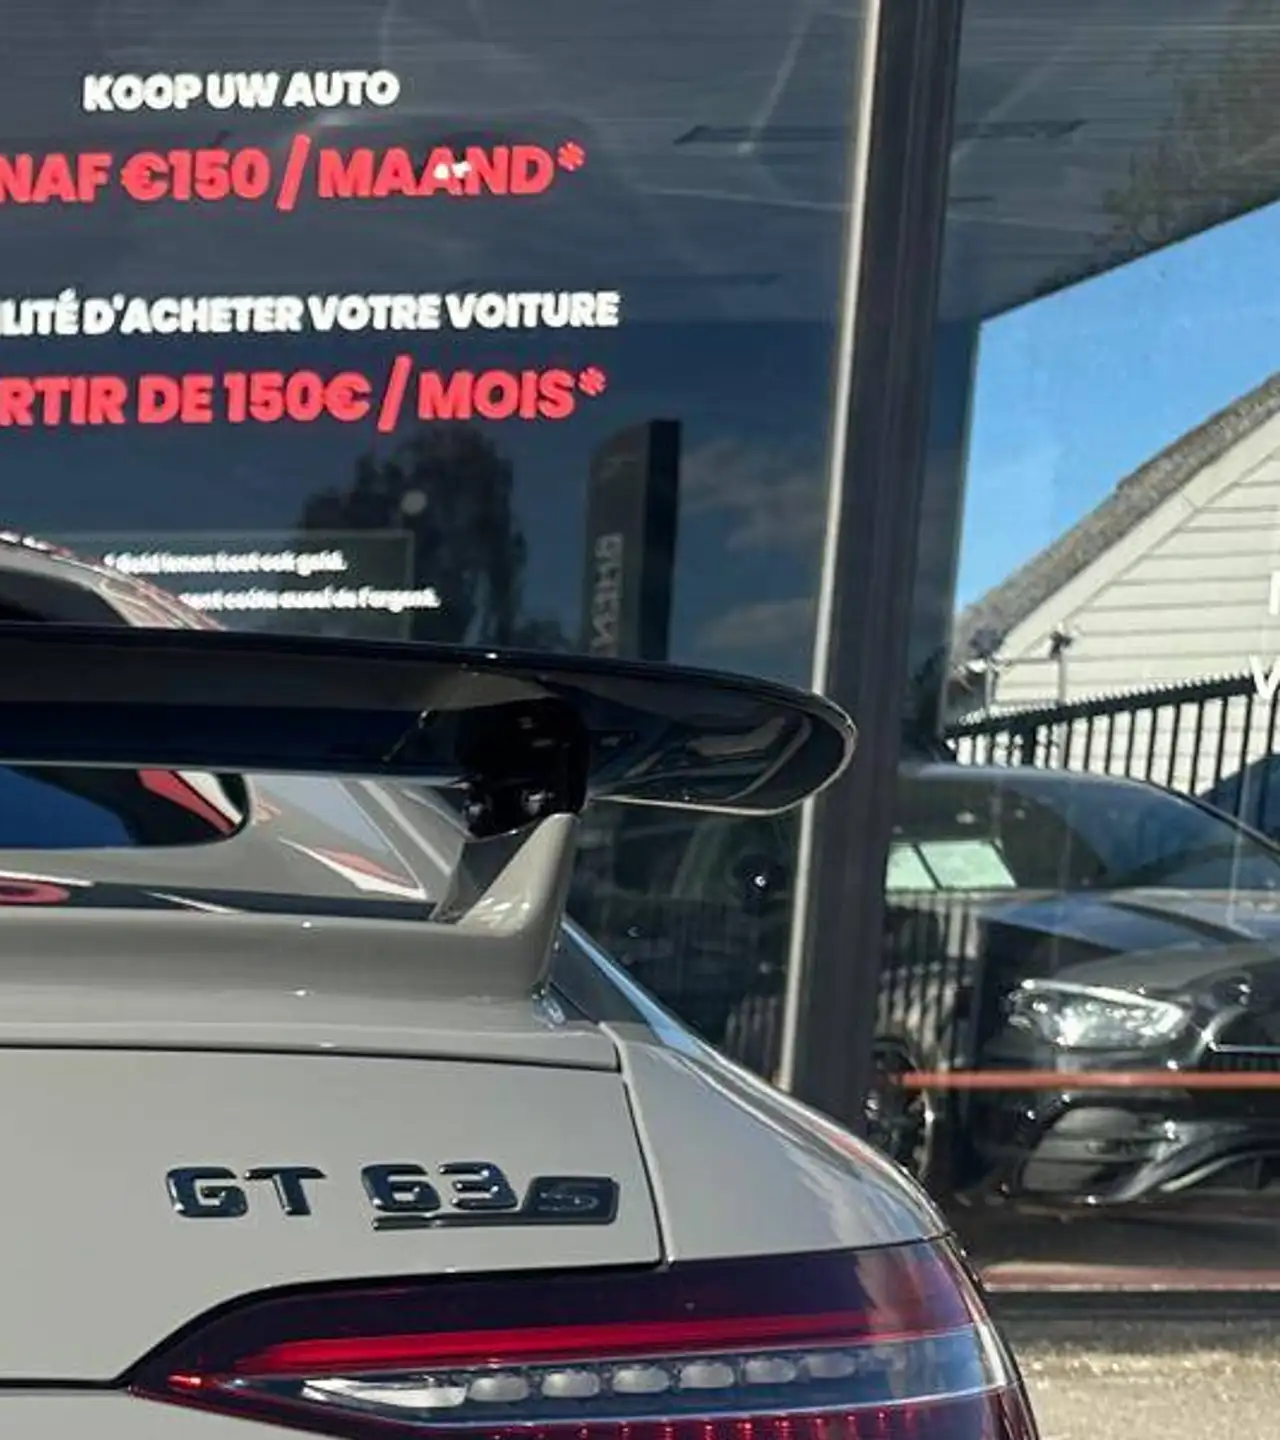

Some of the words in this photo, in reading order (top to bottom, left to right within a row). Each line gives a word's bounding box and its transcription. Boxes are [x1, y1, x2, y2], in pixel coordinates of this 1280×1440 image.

[82, 73, 203, 112] KOOP
[206, 73, 279, 109] UW
[283, 69, 400, 107] AUTO
[83, 293, 303, 335] D'ACHETER
[308, 294, 441, 332] VOTRE
[445, 291, 621, 329] VOITURE
[138, 373, 214, 424] DE
[165, 1166, 327, 1217] GT
